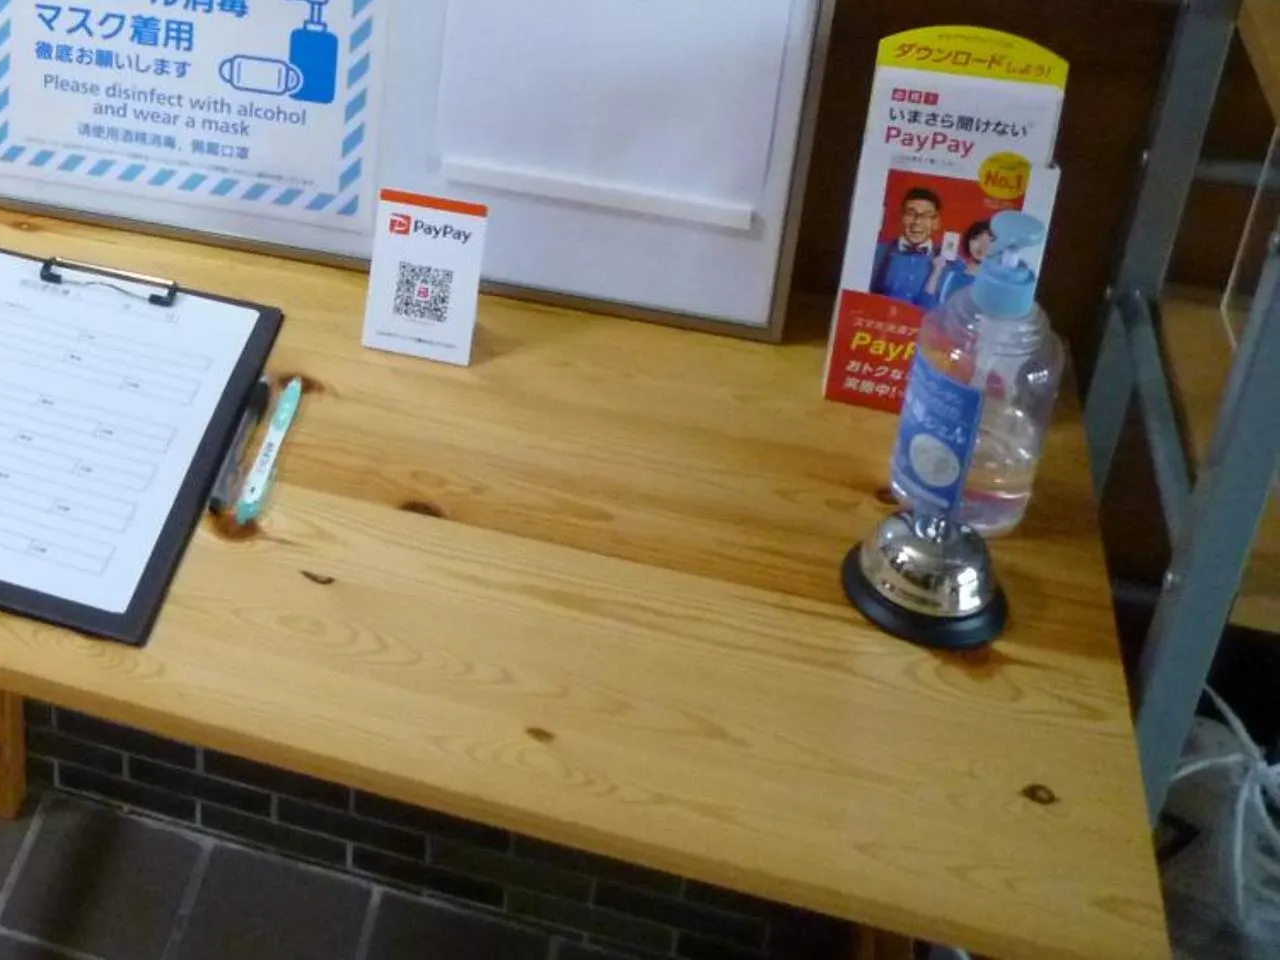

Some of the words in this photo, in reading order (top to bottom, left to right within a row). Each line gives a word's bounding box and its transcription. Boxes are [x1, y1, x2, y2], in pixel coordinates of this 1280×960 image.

[35, 3, 195, 52] マスク着用
[35, 41, 191, 78] 徹底お願いします
[43, 73, 101, 96] Please
[105, 84, 183, 107] disinfect
[189, 97, 232, 115] with
[237, 103, 308, 126] alcohol
[93, 101, 128, 119] and
[133, 110, 180, 126] wear
[185, 118, 196, 129] a
[201, 118, 250, 137] mask
[884, 126, 975, 158] PayPay
[413, 220, 472, 244] PayPay
